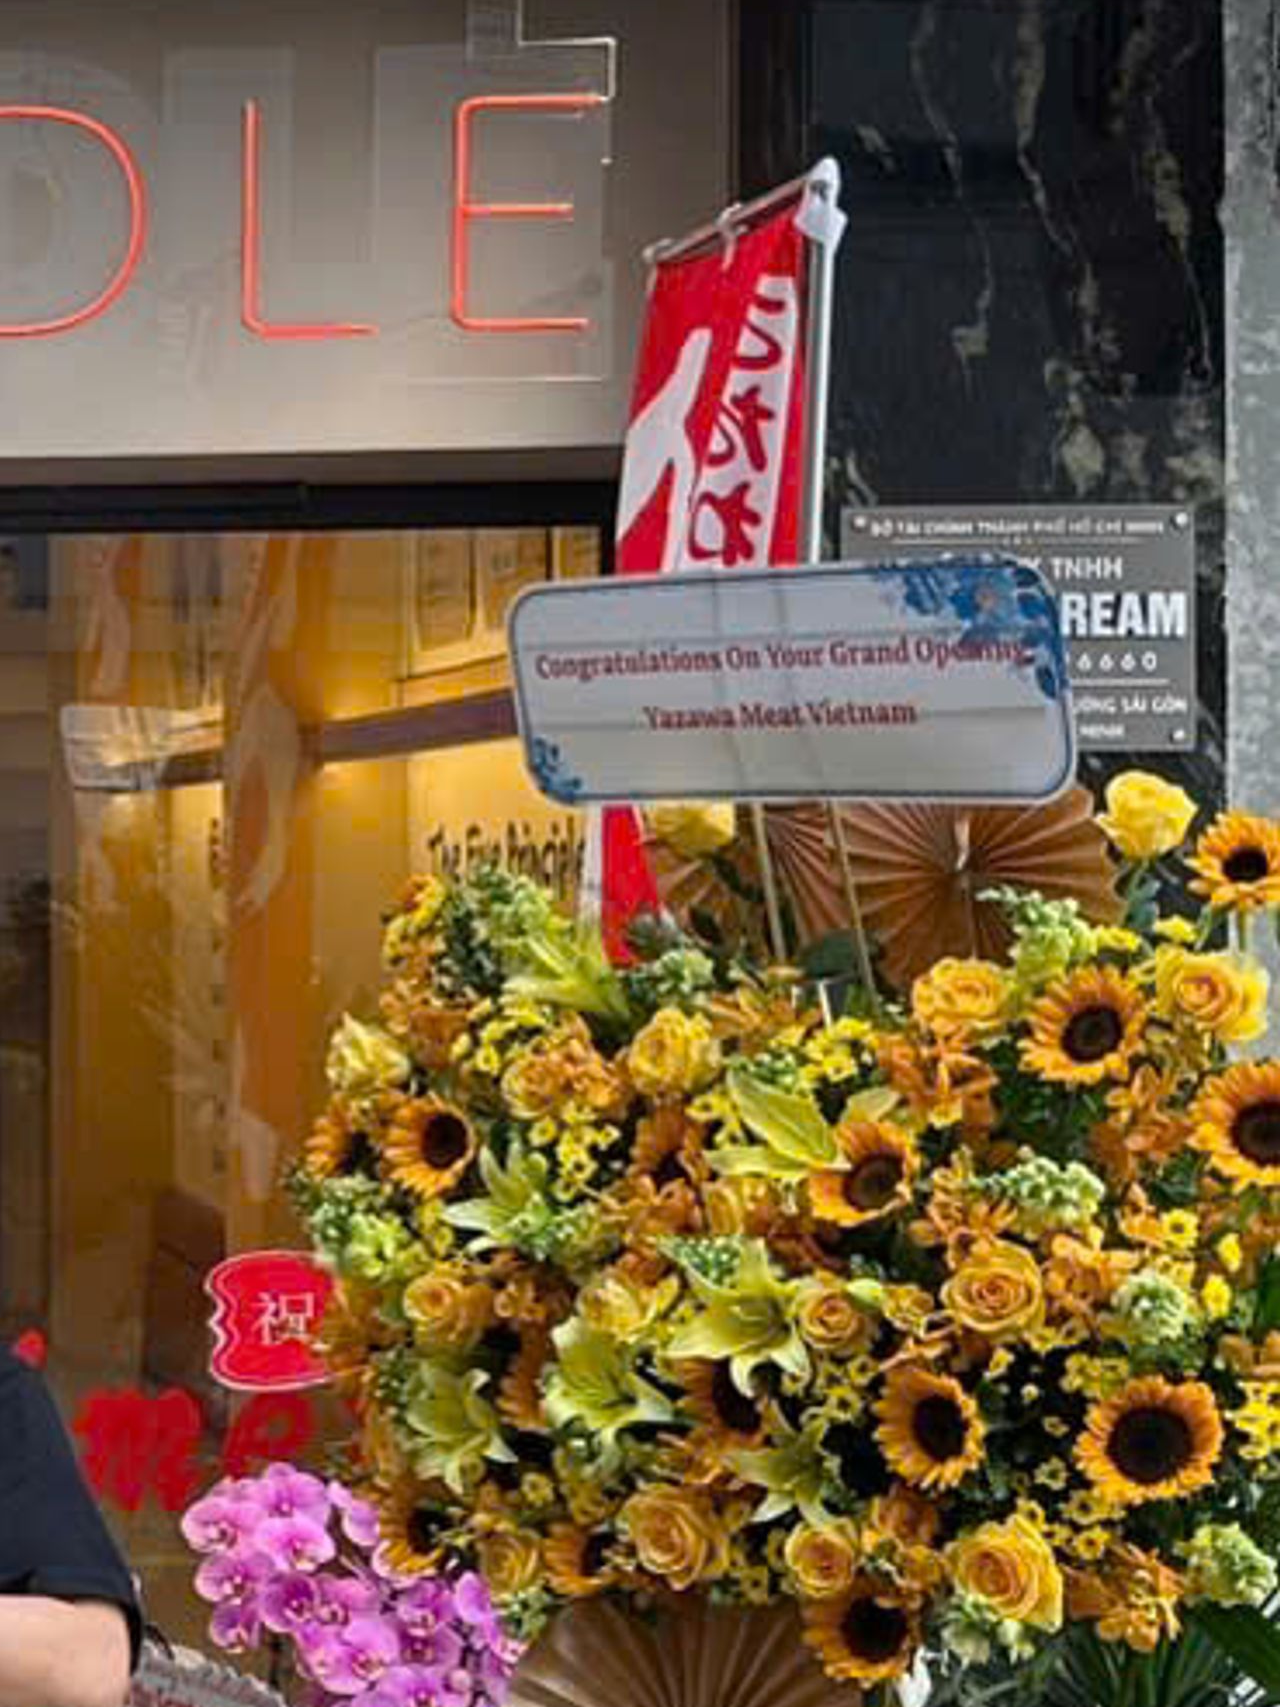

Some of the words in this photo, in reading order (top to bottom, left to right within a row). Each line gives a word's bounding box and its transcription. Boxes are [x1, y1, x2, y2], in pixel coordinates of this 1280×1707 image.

[1049, 557, 1123, 581] TNHH
[535, 647, 721, 682] Congratulations
[725, 646, 761, 670] On
[766, 643, 824, 668] Your
[830, 636, 909, 666] Grand
[915, 636, 1035, 671] Opening
[643, 705, 736, 731] Yazawa
[740, 702, 801, 729] Meat
[806, 699, 917, 726] Vietnam
